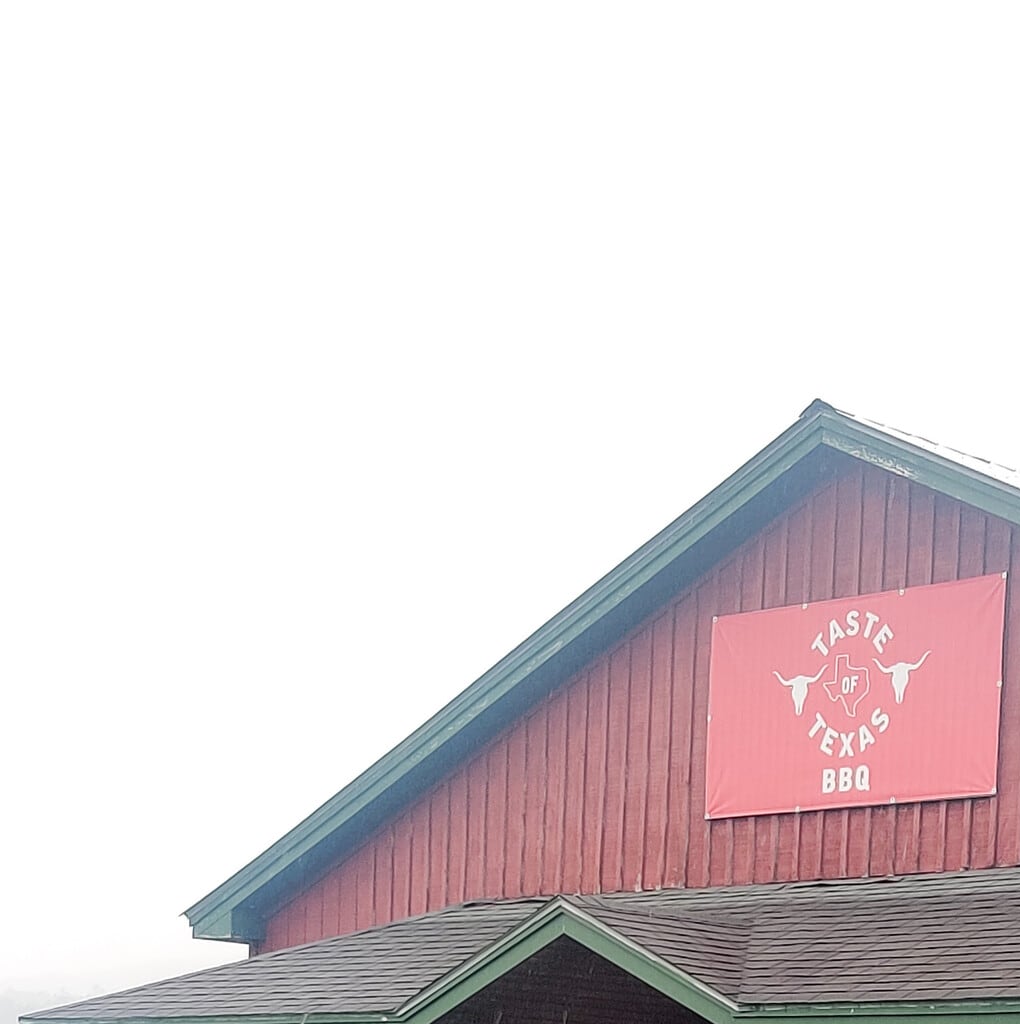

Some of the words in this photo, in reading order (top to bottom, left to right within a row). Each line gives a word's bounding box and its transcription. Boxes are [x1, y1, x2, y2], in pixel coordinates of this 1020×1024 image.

[811, 610, 894, 657] TASTE
[841, 675, 859, 694] OF
[808, 707, 890, 758] TEXAS
[822, 764, 870, 794] BBQ
